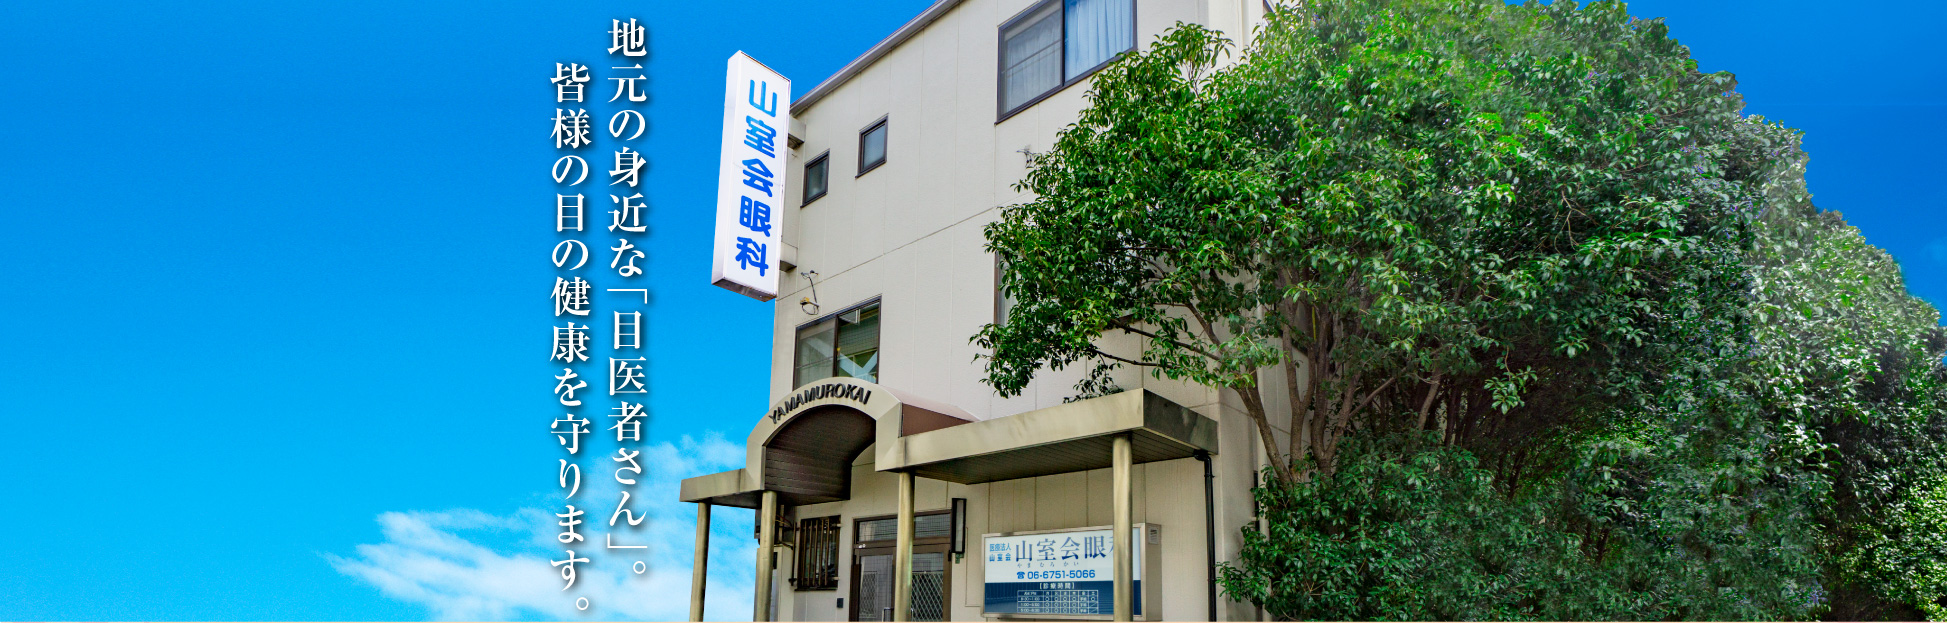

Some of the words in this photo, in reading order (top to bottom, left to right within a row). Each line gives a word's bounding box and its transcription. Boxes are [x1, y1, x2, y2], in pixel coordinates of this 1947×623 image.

[735, 79, 778, 278] 山室会眼科
[768, 383, 872, 425] YAMAMUROKAI
[1015, 535, 1114, 562] 山室会眼
